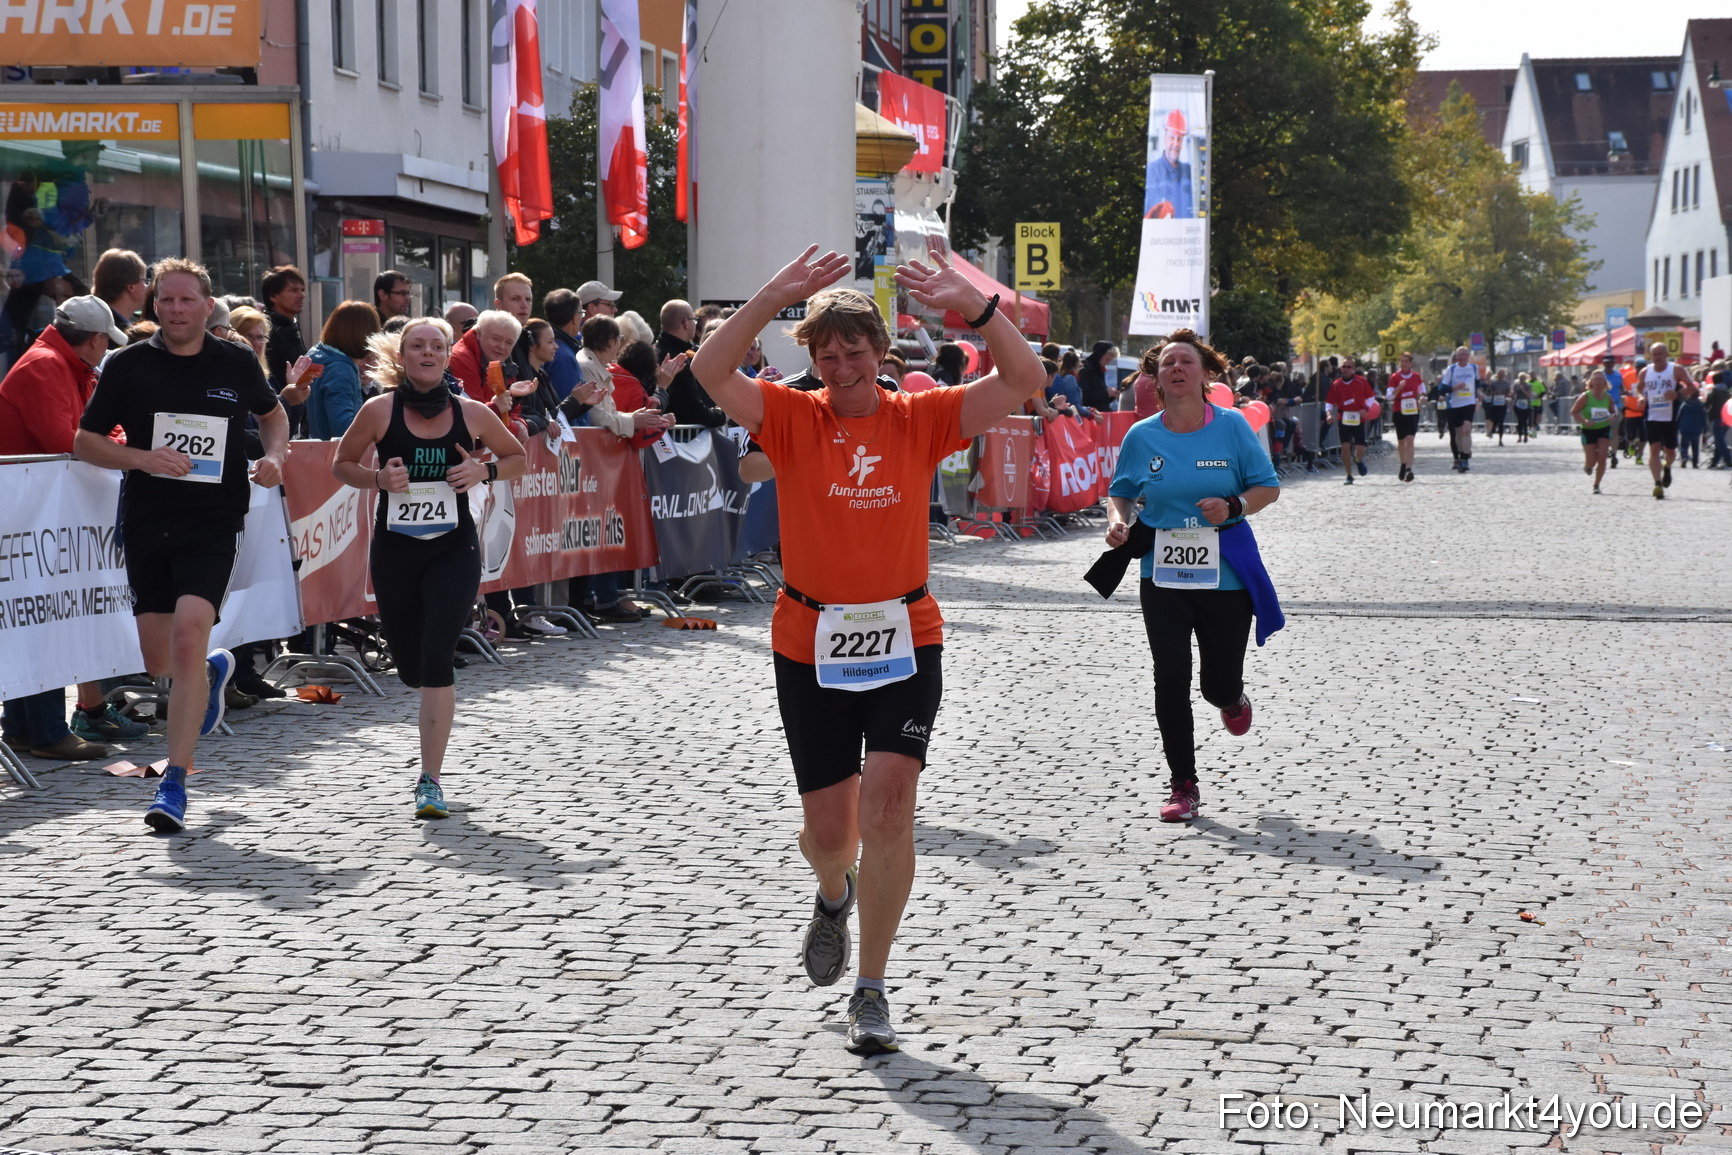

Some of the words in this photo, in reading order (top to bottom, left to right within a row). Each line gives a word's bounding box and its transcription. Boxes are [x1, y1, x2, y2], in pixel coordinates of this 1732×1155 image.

[909, 0, 946, 88] OT
[1021, 226, 1055, 238] Block
[1027, 243, 1049, 275] B
[1324, 323, 1337, 341] C
[1385, 343, 1395, 357] D
[1669, 339, 1679, 353] D
[164, 432, 215, 456] 2262
[414, 448, 446, 464] RUN
[1196, 460, 1229, 468] BOCK
[522, 463, 558, 498] meisten
[828, 483, 894, 498] funrunners
[651, 490, 708, 519] RAIL.ONE
[849, 492, 901, 509] neumarkt
[398, 501, 446, 521] 2724
[1183, 516, 1202, 528] 18.
[1163, 545, 1209, 566] 2302
[1177, 571, 1194, 579] Mara
[6, 589, 80, 629] VERBRAUCH.
[853, 611, 885, 621] BOCK
[830, 627, 896, 658] 2227
[842, 664, 890, 677] Hildegard
[902, 719, 928, 736] live
